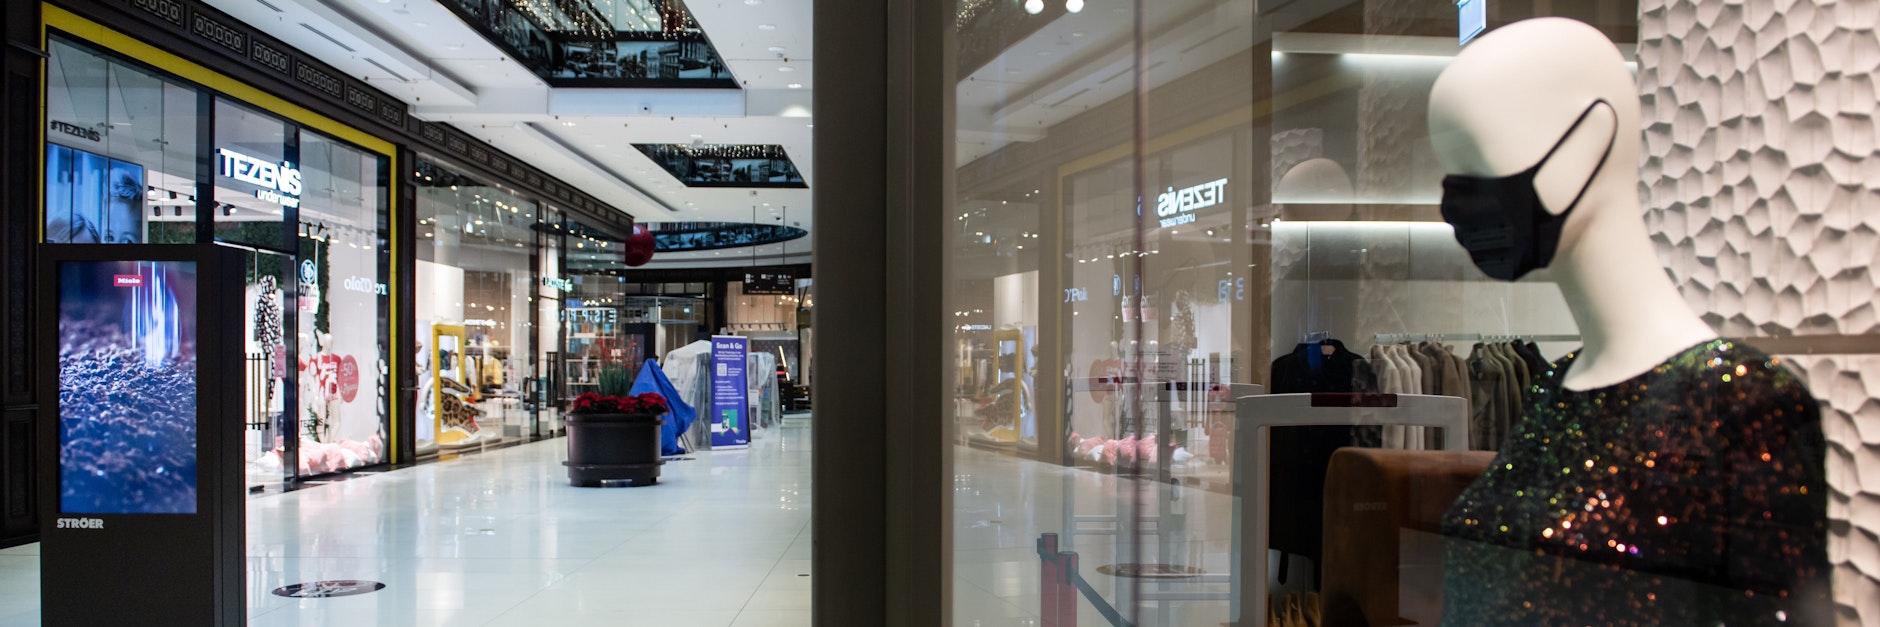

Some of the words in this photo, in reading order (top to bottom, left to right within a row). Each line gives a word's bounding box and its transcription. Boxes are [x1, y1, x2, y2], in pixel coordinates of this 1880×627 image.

[256, 189, 300, 209] underwear
[730, 342, 735, 350] &
[735, 342, 743, 350] Go
[56, 517, 104, 529] STRÖER
